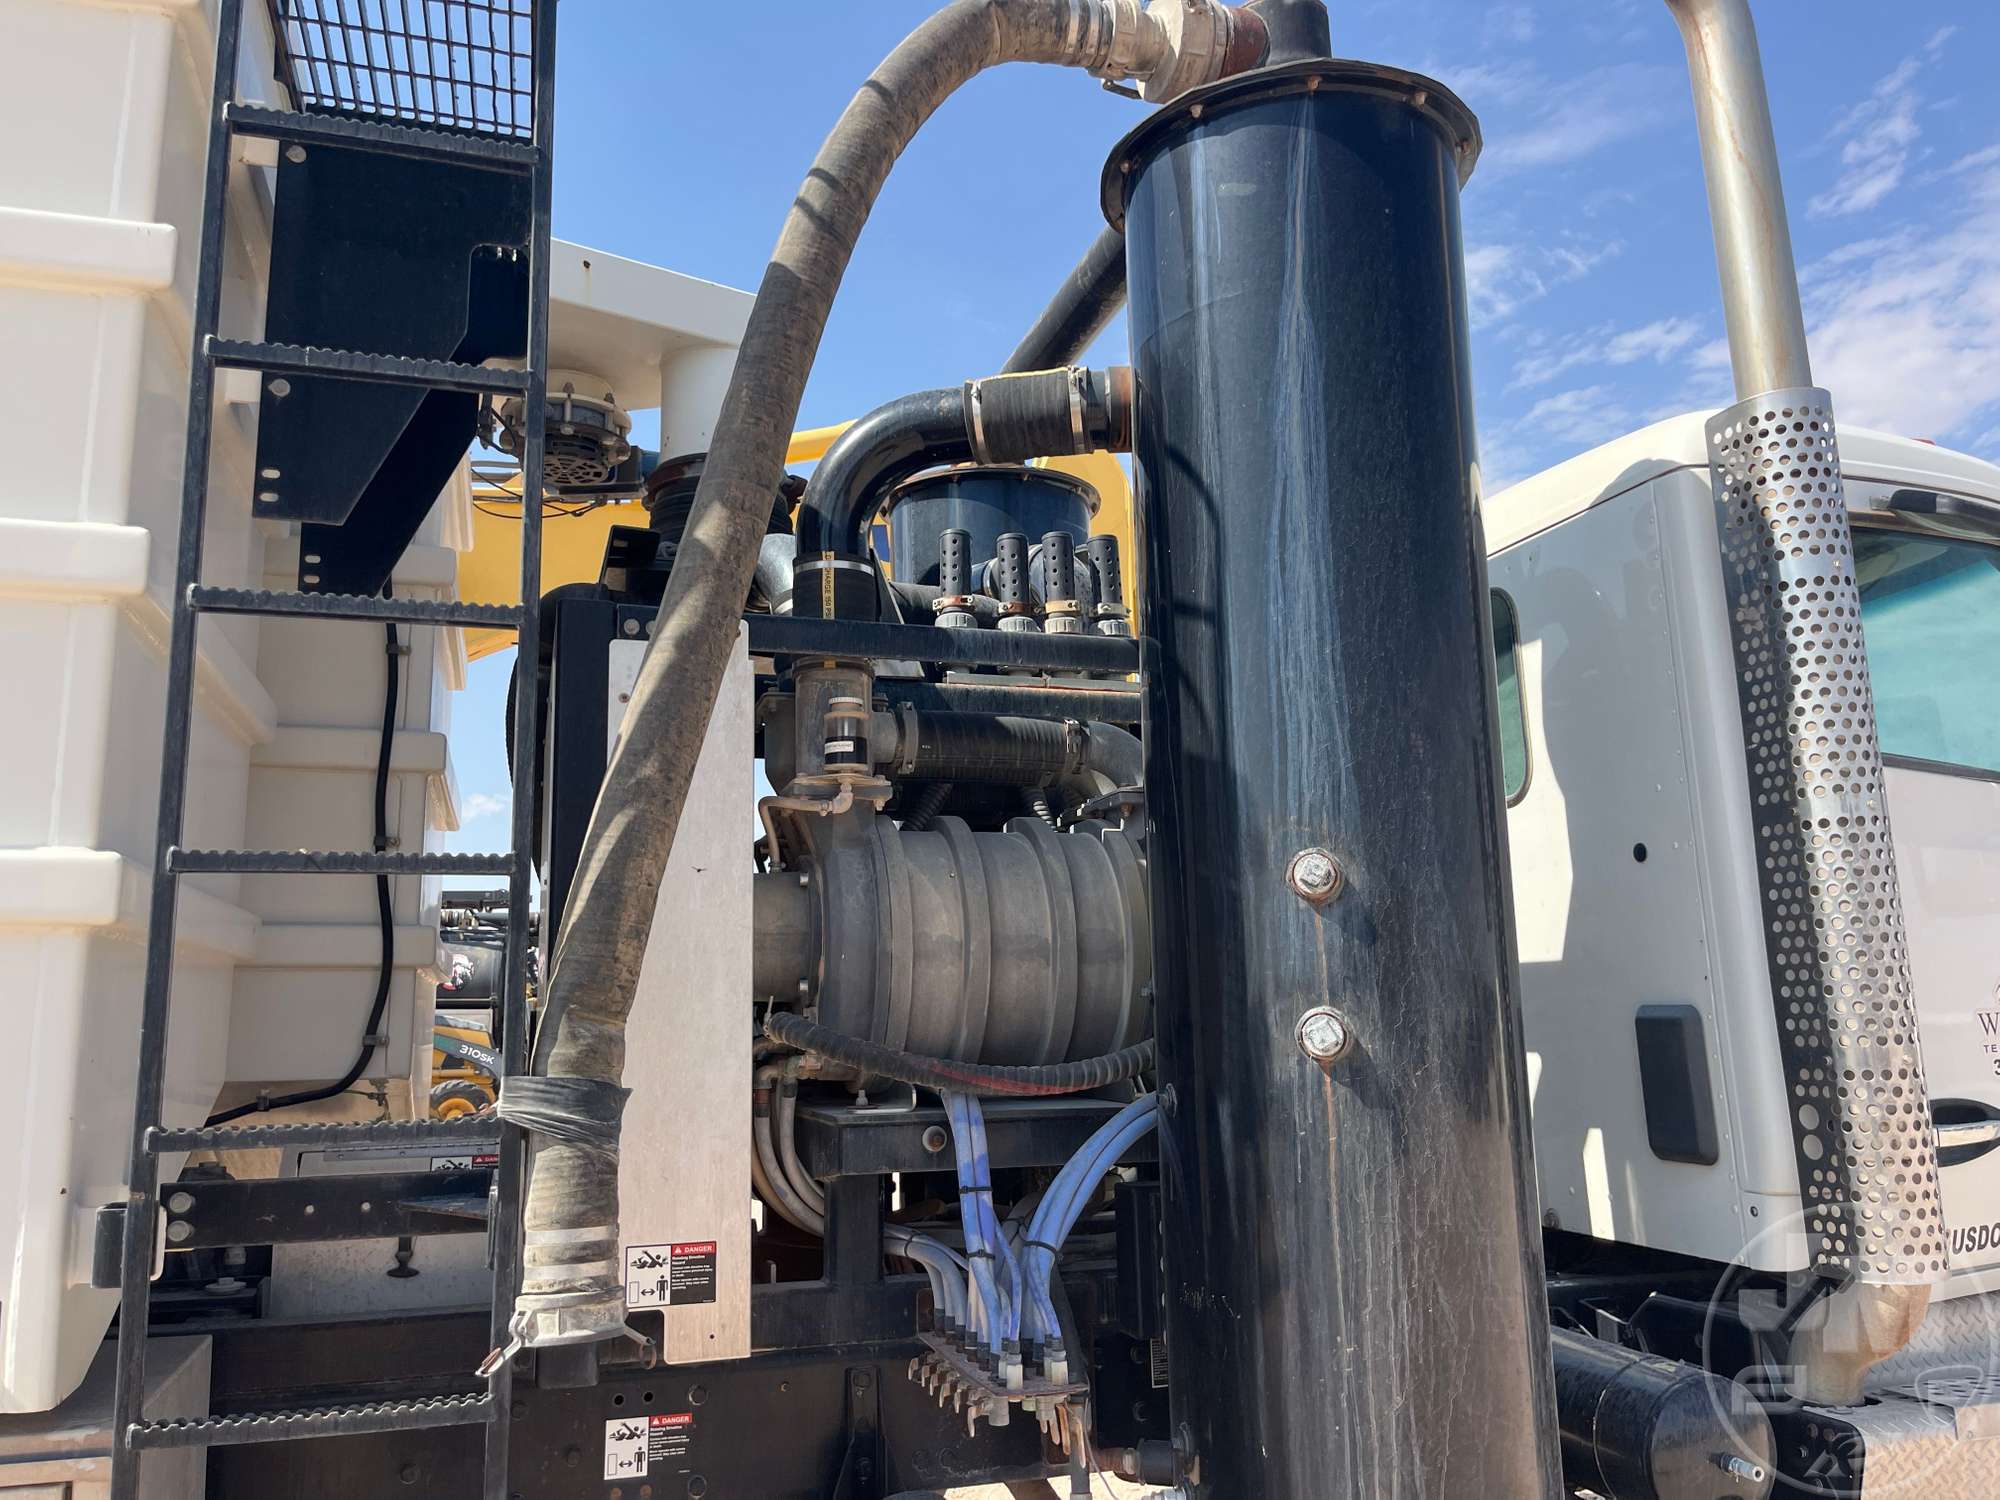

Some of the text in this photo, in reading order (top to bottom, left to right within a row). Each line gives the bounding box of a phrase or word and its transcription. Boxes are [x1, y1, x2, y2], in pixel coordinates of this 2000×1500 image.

[459, 1044, 495, 1065] 310SK
[684, 1245, 713, 1253] DANGER
[661, 1415, 690, 1424] DANGER
